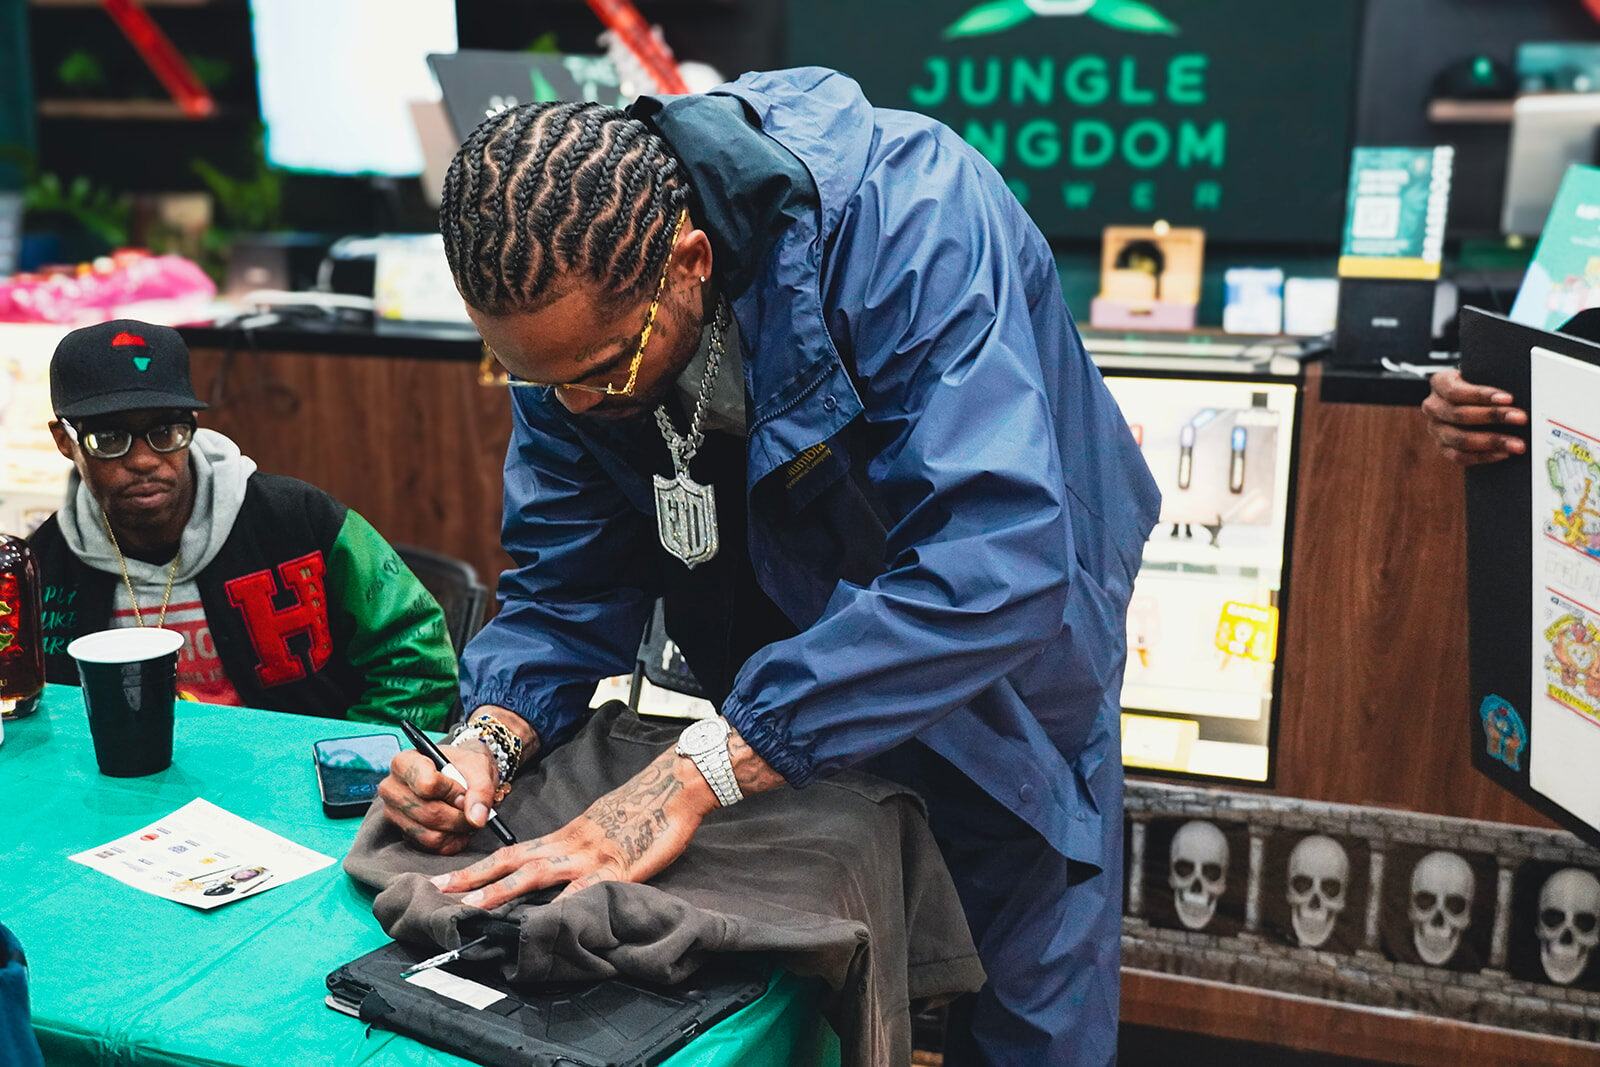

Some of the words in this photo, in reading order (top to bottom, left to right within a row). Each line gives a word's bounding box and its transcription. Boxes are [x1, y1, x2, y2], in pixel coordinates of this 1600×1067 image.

[910, 54, 1208, 106] JUNGLE
[965, 120, 1226, 169] NGDOM
[1008, 179, 1221, 210] OWER
[224, 550, 333, 688] H
